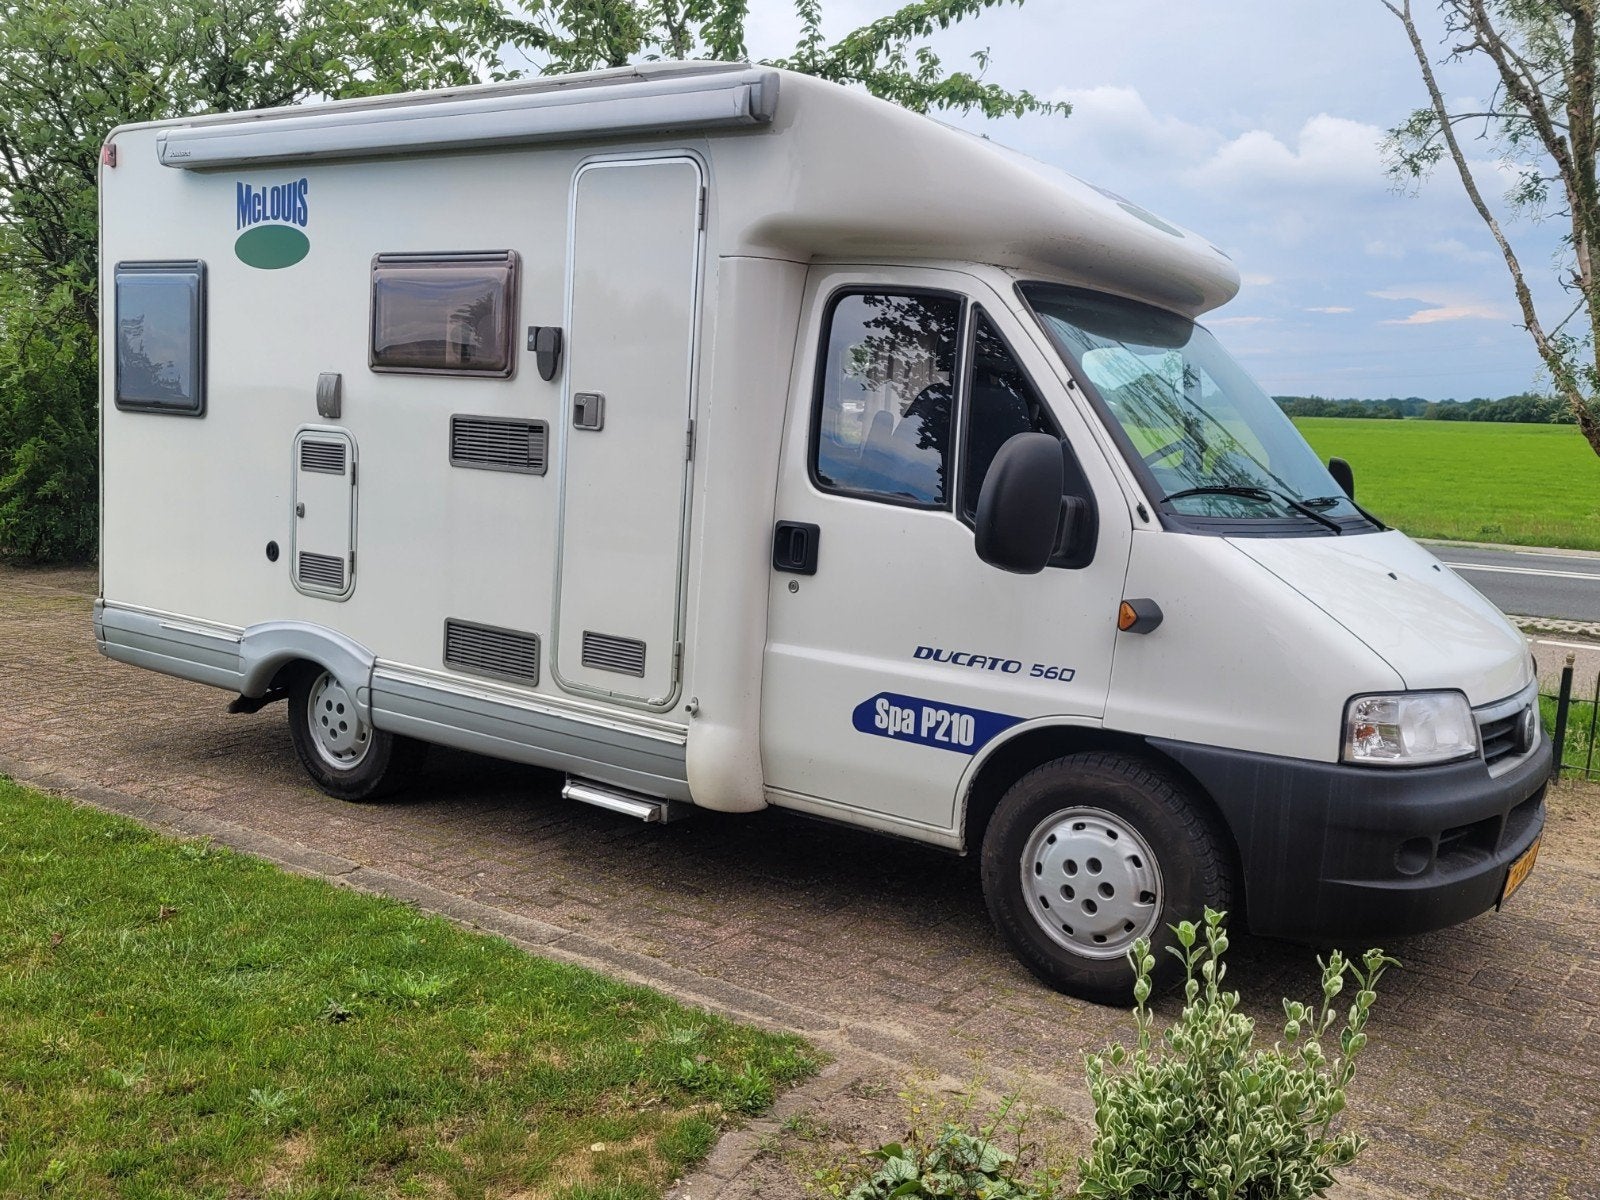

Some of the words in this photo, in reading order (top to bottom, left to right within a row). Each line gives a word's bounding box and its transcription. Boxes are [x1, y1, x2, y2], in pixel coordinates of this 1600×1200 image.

[913, 645, 1022, 674] DUCATO
[1029, 664, 1076, 682] 560
[874, 697, 915, 736] Spa
[920, 706, 975, 747] P210
